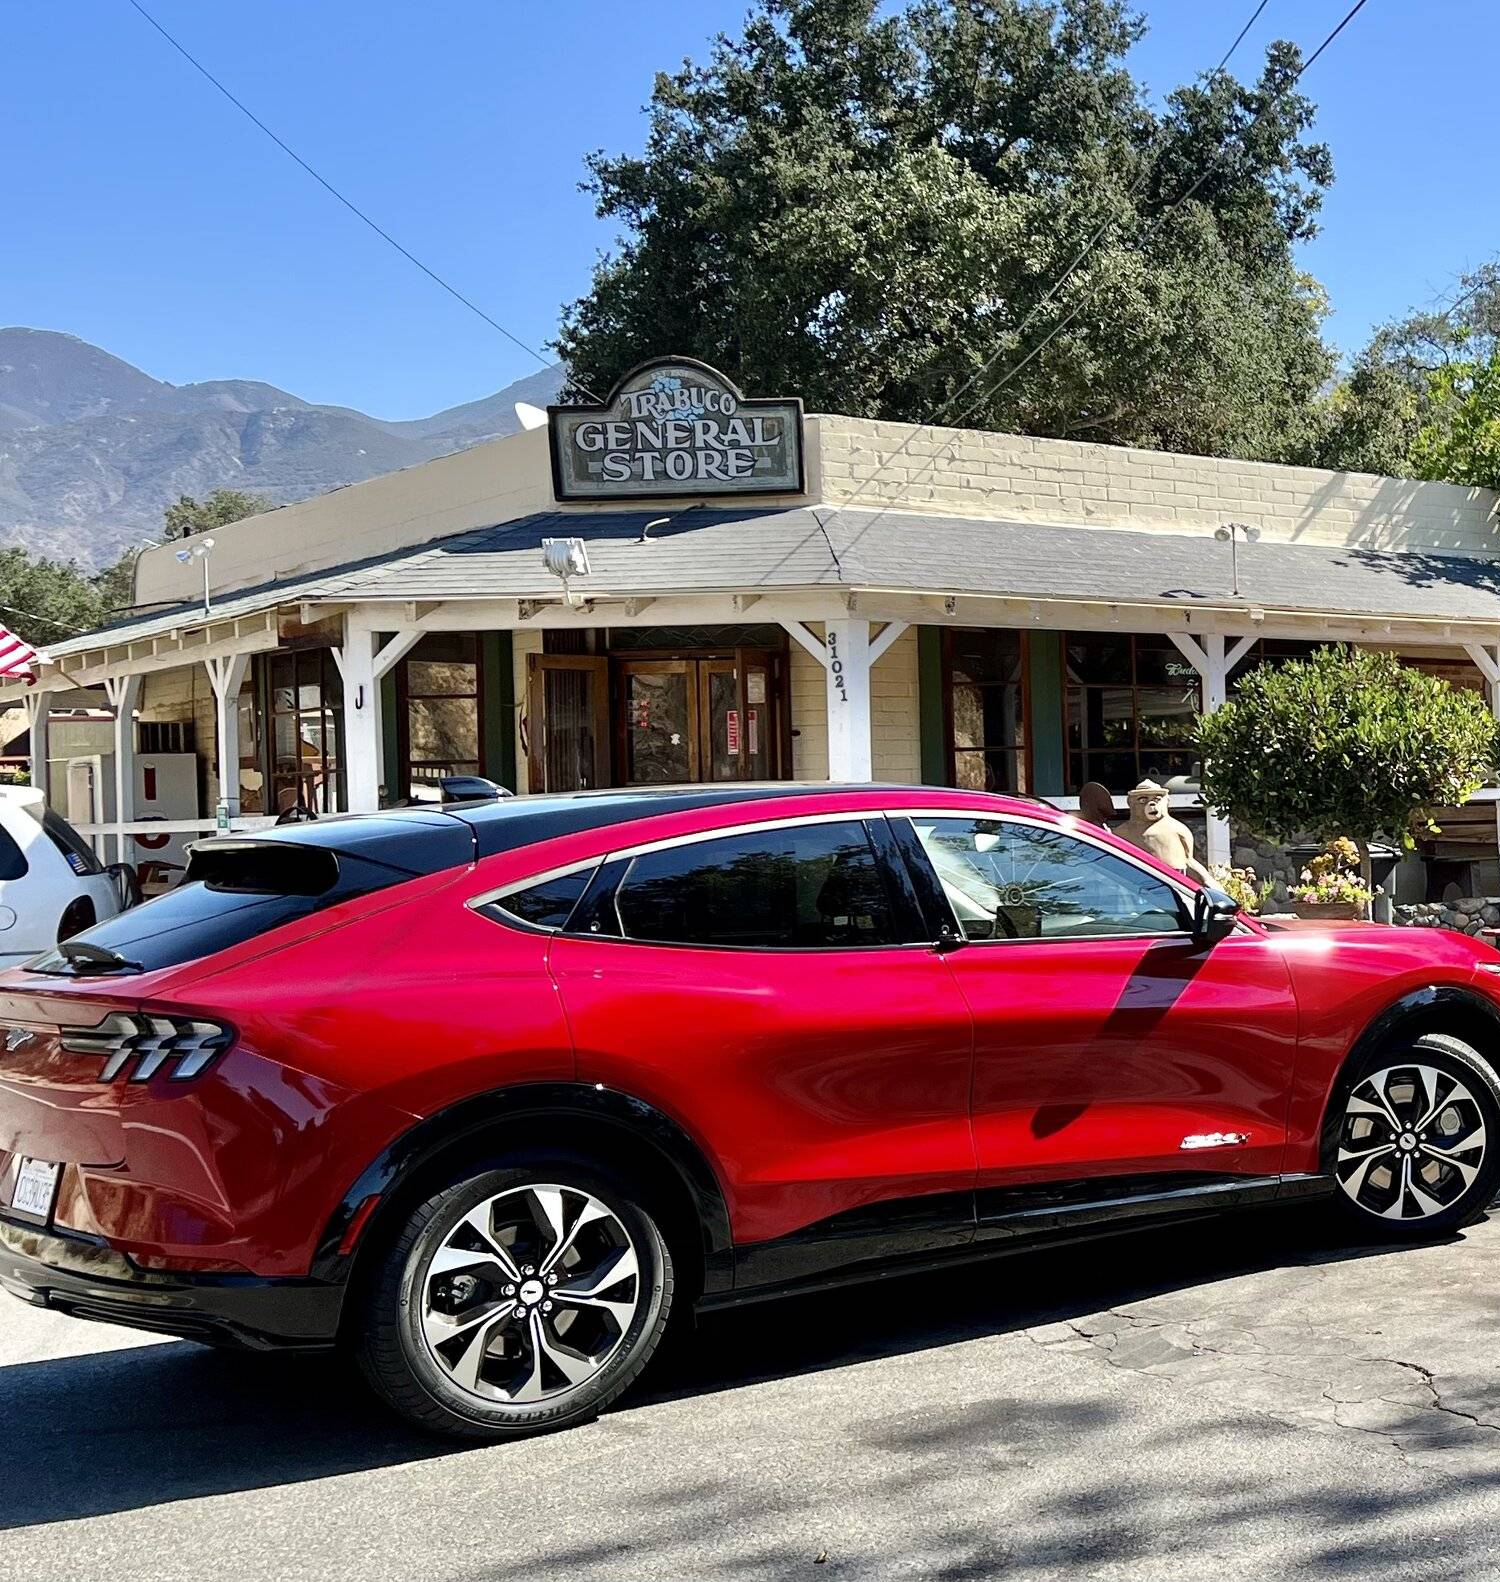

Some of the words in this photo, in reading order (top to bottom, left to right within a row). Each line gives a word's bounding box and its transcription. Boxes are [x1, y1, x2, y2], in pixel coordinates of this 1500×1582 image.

[621, 387, 737, 419] TRABUCO
[575, 418, 782, 451] GENERAL
[601, 448, 758, 482] STORE
[827, 632, 848, 702] 31021
